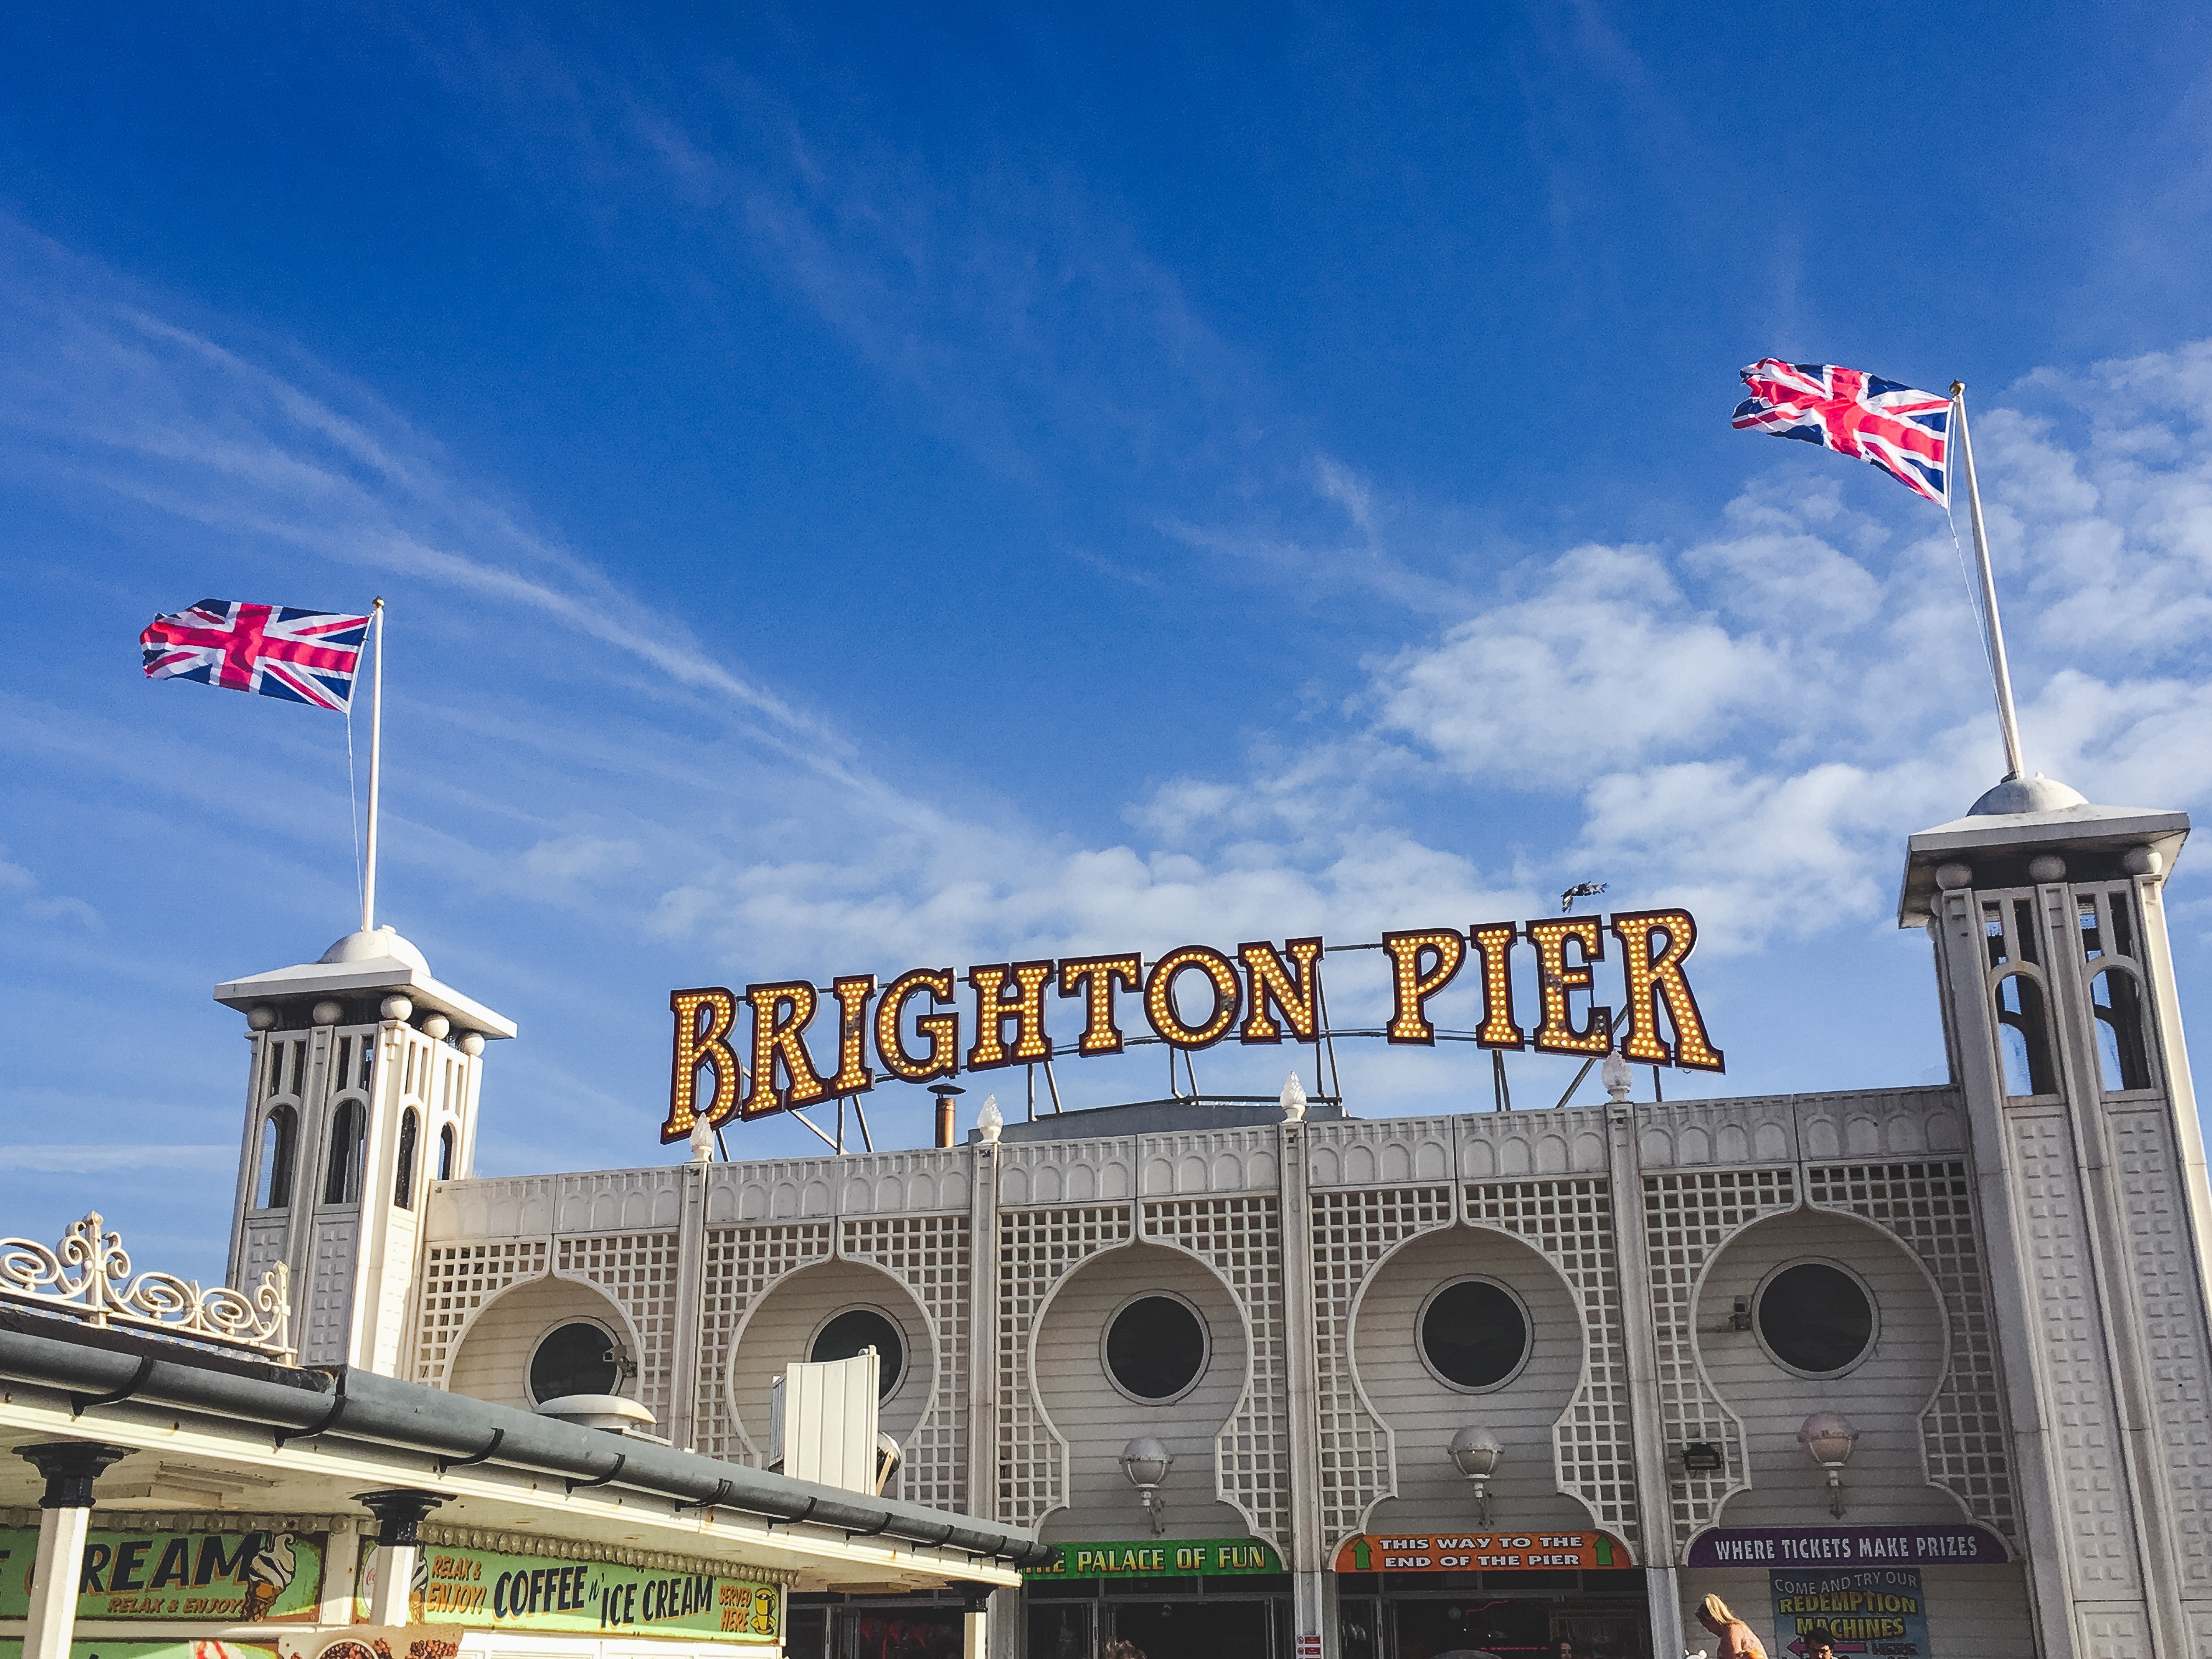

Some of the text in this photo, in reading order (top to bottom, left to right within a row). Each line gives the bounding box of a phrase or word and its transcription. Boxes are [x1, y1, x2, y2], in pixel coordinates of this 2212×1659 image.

[661, 907, 1725, 1144] BRIGHTON PIER
[1379, 1536, 1583, 1549] THIS WAY TO THE
[1714, 1536, 1978, 1560] WHERE TICKETS MAKE PRIZES
[25, 1532, 263, 1596] REAM
[431, 1555, 482, 1581] RELAX &
[1077, 1549, 1167, 1572] PALACE
[1176, 1547, 1206, 1570] OF
[1218, 1545, 1265, 1568] FUN
[1385, 1554, 1580, 1567] END OF THE PIER
[1775, 1571, 1918, 1594] COME AND TRY OUR
[106, 1598, 166, 1614] RELAX
[167, 1599, 179, 1613] &
[426, 1582, 488, 1615] ENJOY!
[493, 1565, 589, 1623] COFFEE
[600, 1583, 637, 1633] ICE
[642, 1575, 714, 1624] CREAM
[718, 1584, 753, 1609] SERVED
[1779, 1591, 1917, 1613] REDEMPTION
[721, 1607, 751, 1633] HERE
[1796, 1618, 1905, 1639] MACHINES
[1871, 1642, 1918, 1656] HERE
